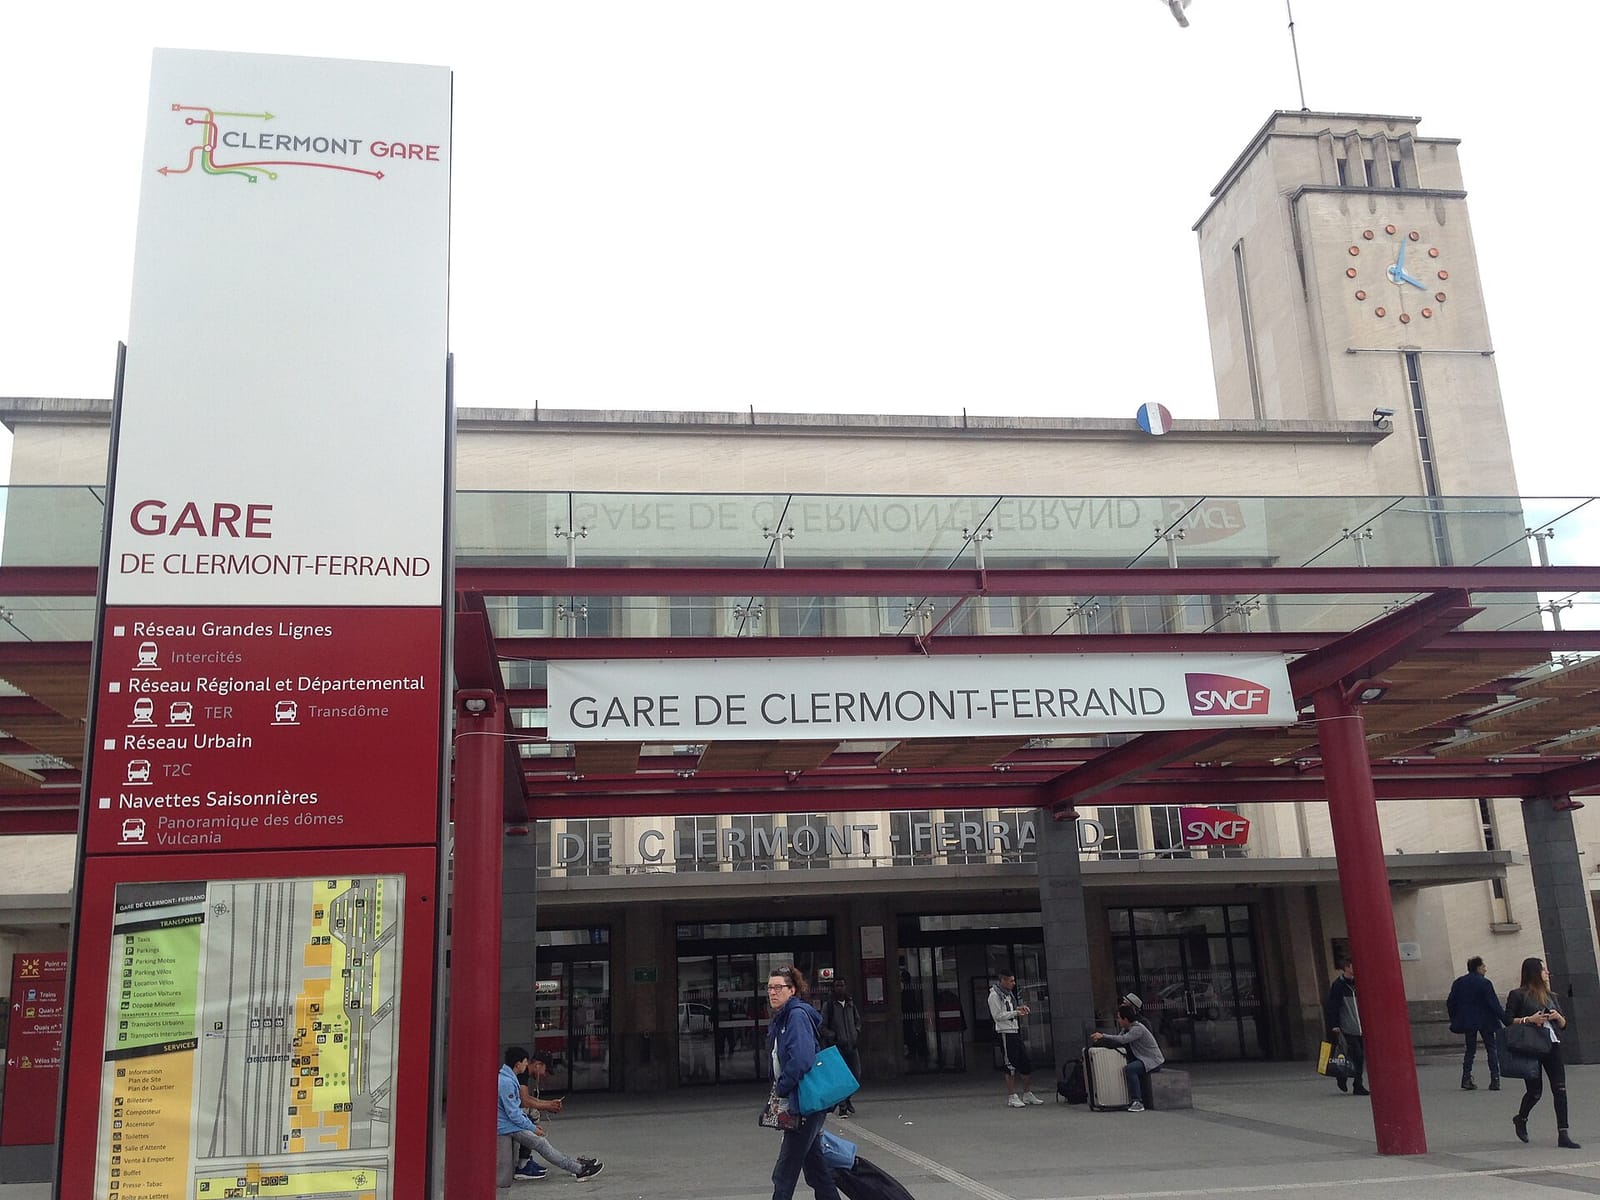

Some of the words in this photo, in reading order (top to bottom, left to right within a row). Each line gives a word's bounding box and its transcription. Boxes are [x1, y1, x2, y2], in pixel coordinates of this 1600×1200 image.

[222, 131, 362, 155] CLERMONT
[369, 141, 440, 161] GARE
[130, 499, 273, 538] GARE
[120, 553, 155, 574] DE
[163, 554, 430, 577] CLERMONT-FERRAND
[133, 621, 196, 637] Réseau
[202, 621, 273, 637] Grandes
[279, 621, 333, 641] Lignes
[171, 649, 242, 663] Intercités
[128, 677, 191, 693] Réseau
[196, 677, 271, 697] Régional
[275, 678, 293, 692] et
[298, 675, 425, 697] Départemental
[205, 707, 233, 719] TER
[308, 704, 389, 718] Transdôme
[569, 694, 679, 728] GARE
[696, 693, 747, 726] DE
[760, 687, 1165, 724] CLERMONT-FERRAND
[1193, 689, 1264, 711] SNCF
[124, 734, 188, 750] Réseau
[193, 733, 252, 749] Urbain
[163, 763, 192, 777] T2C
[119, 793, 201, 809] Navettes
[206, 790, 318, 807] Saisonnières
[158, 814, 259, 831] Panoramique
[264, 813, 289, 826] des
[294, 811, 344, 826] dômes
[1186, 820, 1247, 840] SNCF
[157, 831, 222, 845] Vulcania
[557, 831, 612, 864] DE
[160, 916, 202, 927] TRANSPORTS
[136, 947, 160, 955] Parkings
[163, 1041, 195, 1052] SERVICES
